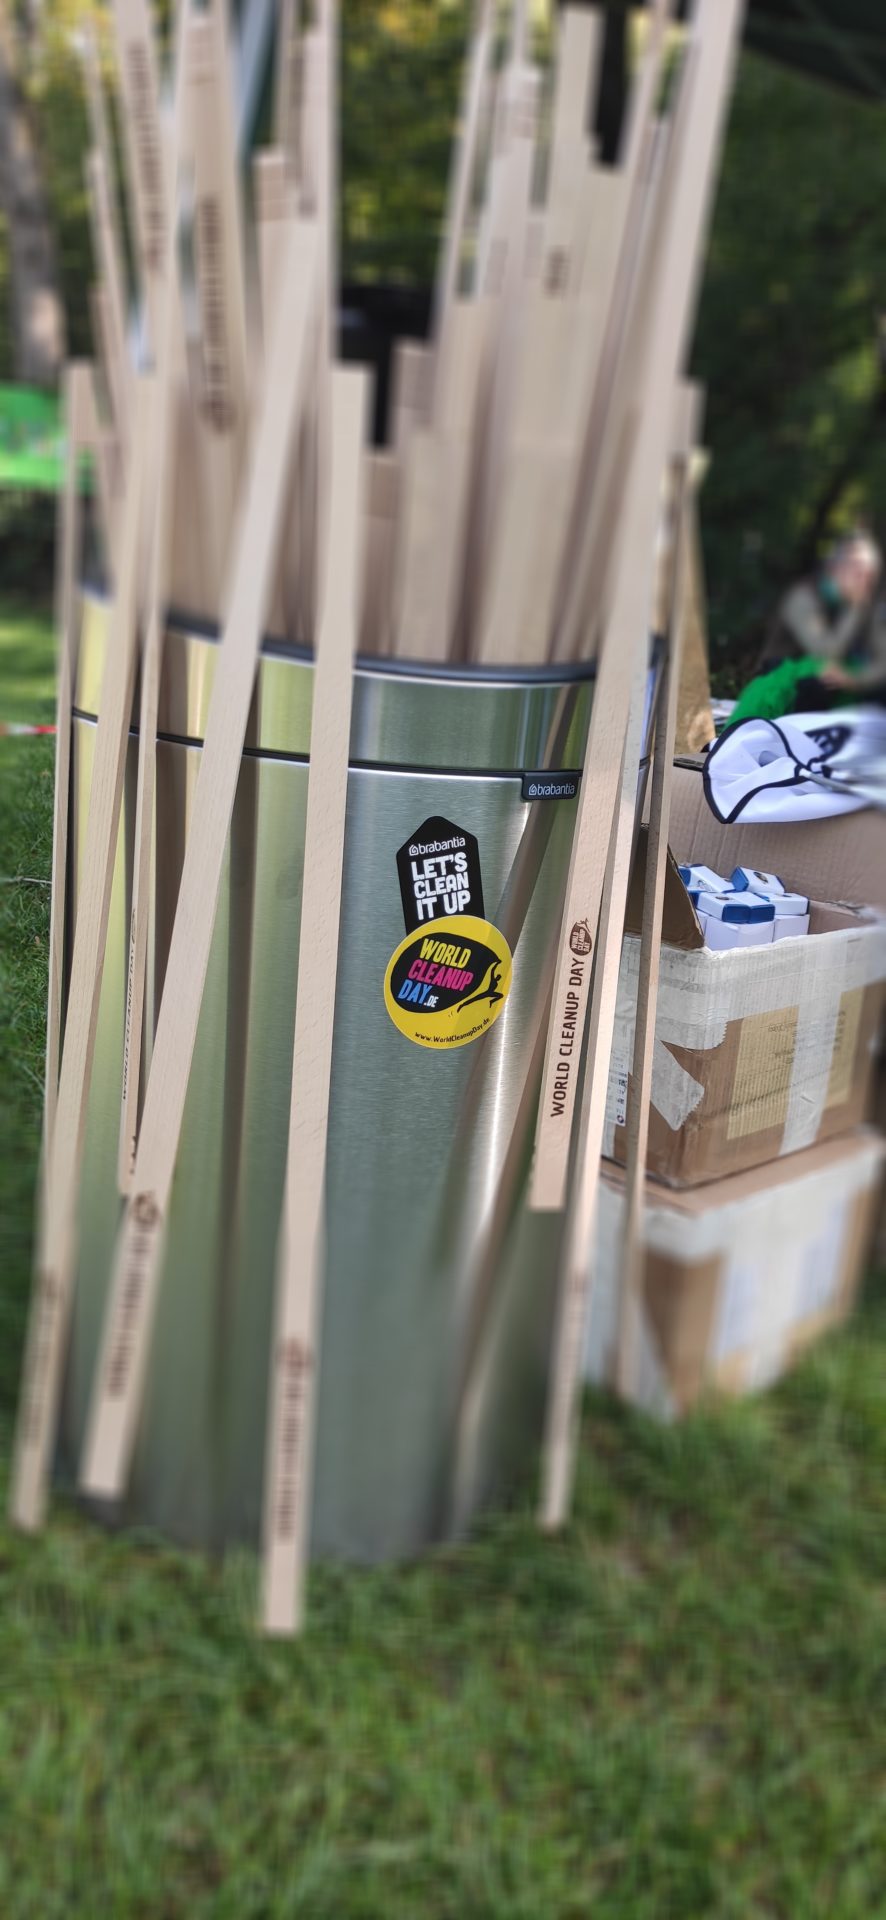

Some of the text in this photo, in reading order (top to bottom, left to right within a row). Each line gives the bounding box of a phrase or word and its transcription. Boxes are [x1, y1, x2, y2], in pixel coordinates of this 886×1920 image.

[537, 783, 575, 796] brabantia
[418, 836, 466, 855] brabantia
[411, 852, 468, 881] LET'S
[414, 872, 470, 899] CLEAN
[416, 890, 471, 920] IT UP
[419, 938, 472, 969] WORLD
[408, 959, 474, 992] CLEANUP
[551, 957, 586, 1118] WORLD CLEANUP DAY
